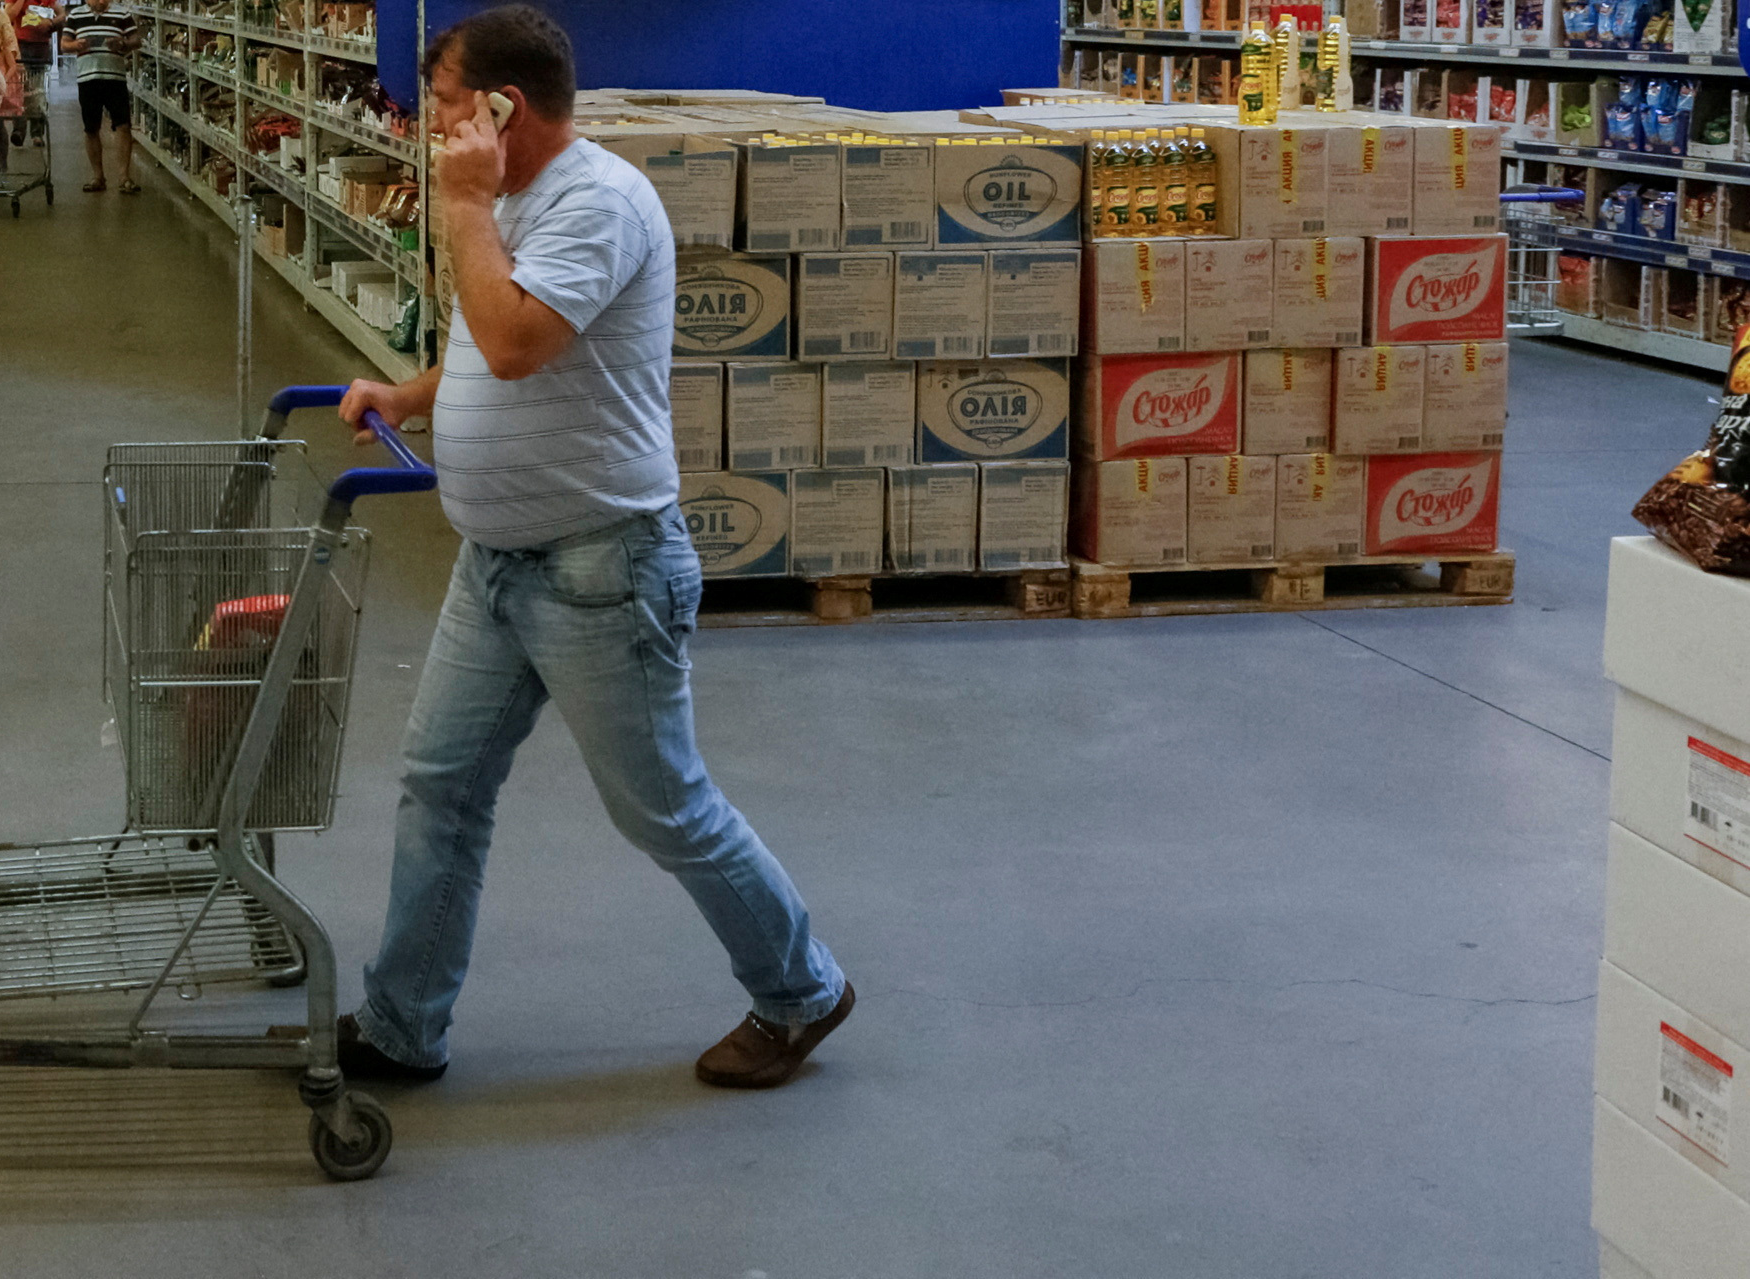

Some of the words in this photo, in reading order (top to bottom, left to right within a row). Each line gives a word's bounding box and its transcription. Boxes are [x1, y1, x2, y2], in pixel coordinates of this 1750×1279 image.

[1283, 150, 1293, 191] АКЦИЯ
[1454, 164, 1465, 190] ЦИЯ
[983, 181, 1031, 201] OIL
[675, 293, 746, 315] ОЛІЯ
[1282, 350, 1293, 391] АКЦИЯ
[1466, 343, 1475, 372] ЦИЯ
[1375, 353, 1387, 392] АКЦИЯ
[959, 395, 1027, 418] ОЛІЯ
[1138, 458, 1148, 492] АКЦИ
[1227, 456, 1239, 495] АКЦИЯ
[685, 512, 736, 534] OIL
